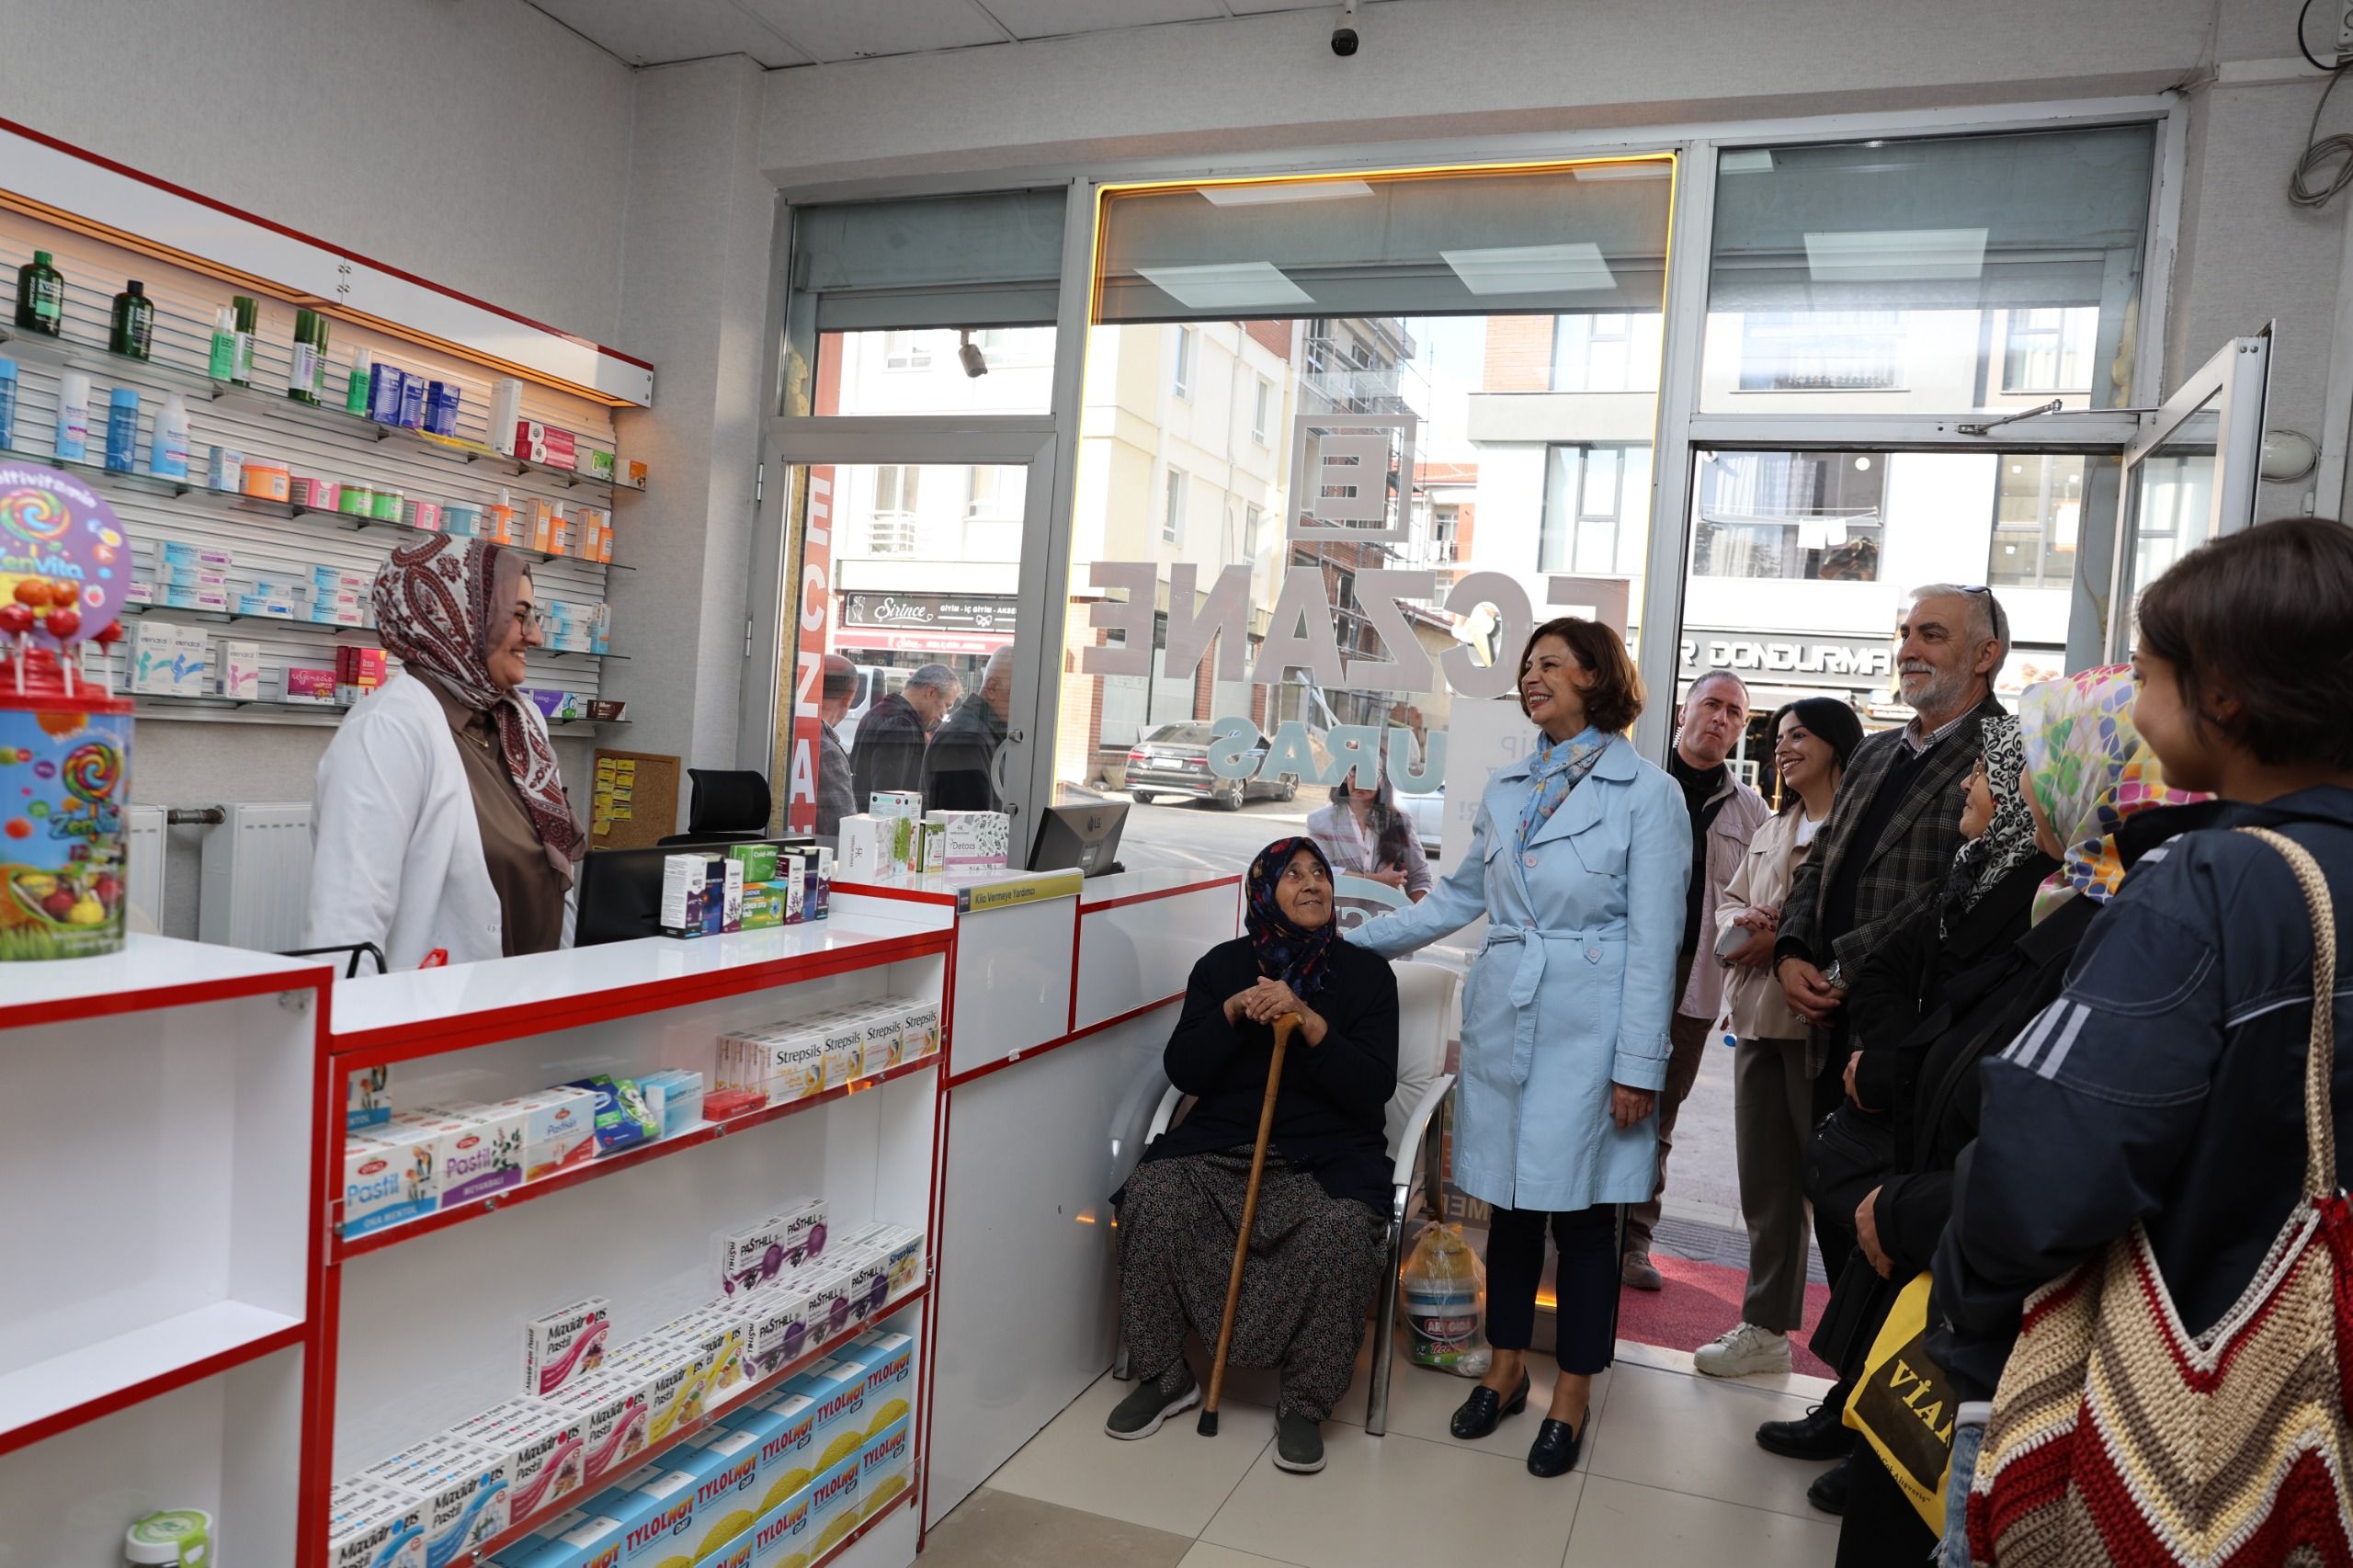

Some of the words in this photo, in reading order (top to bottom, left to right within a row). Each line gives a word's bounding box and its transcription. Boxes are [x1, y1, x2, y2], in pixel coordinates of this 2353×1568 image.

[997, 607, 1017, 615] AKSE
[789, 476, 831, 835] ECZA
[1709, 640, 1892, 676] DONDURMA
[867, 1020, 901, 1040] Strepsils
[905, 1010, 937, 1030] Strepsils
[825, 1031, 860, 1052] Strepsils
[777, 1044, 822, 1065] Strepsils
[447, 1147, 491, 1178] Pastil
[347, 1174, 399, 1206] Pastil
[787, 1213, 817, 1235] PASTHILL
[740, 1234, 773, 1256] PASTHILL
[851, 1266, 879, 1288] PASTHILL
[808, 1288, 838, 1312] PASTHILL
[548, 1308, 608, 1341] Maxidrops
[759, 1312, 793, 1338] PASTHILL
[546, 1335, 572, 1355] Pastil
[654, 1360, 703, 1395] Maxidrops
[589, 1391, 645, 1428] Maxidrops
[654, 1388, 674, 1408] Pastil
[589, 1421, 612, 1443] Pastil
[517, 1426, 580, 1467] Maxidrops
[516, 1460, 542, 1482] Pastil
[433, 1465, 505, 1513] Maxidrops
[432, 1503, 462, 1528] Pastil
[338, 1510, 420, 1564] Maxidrops
